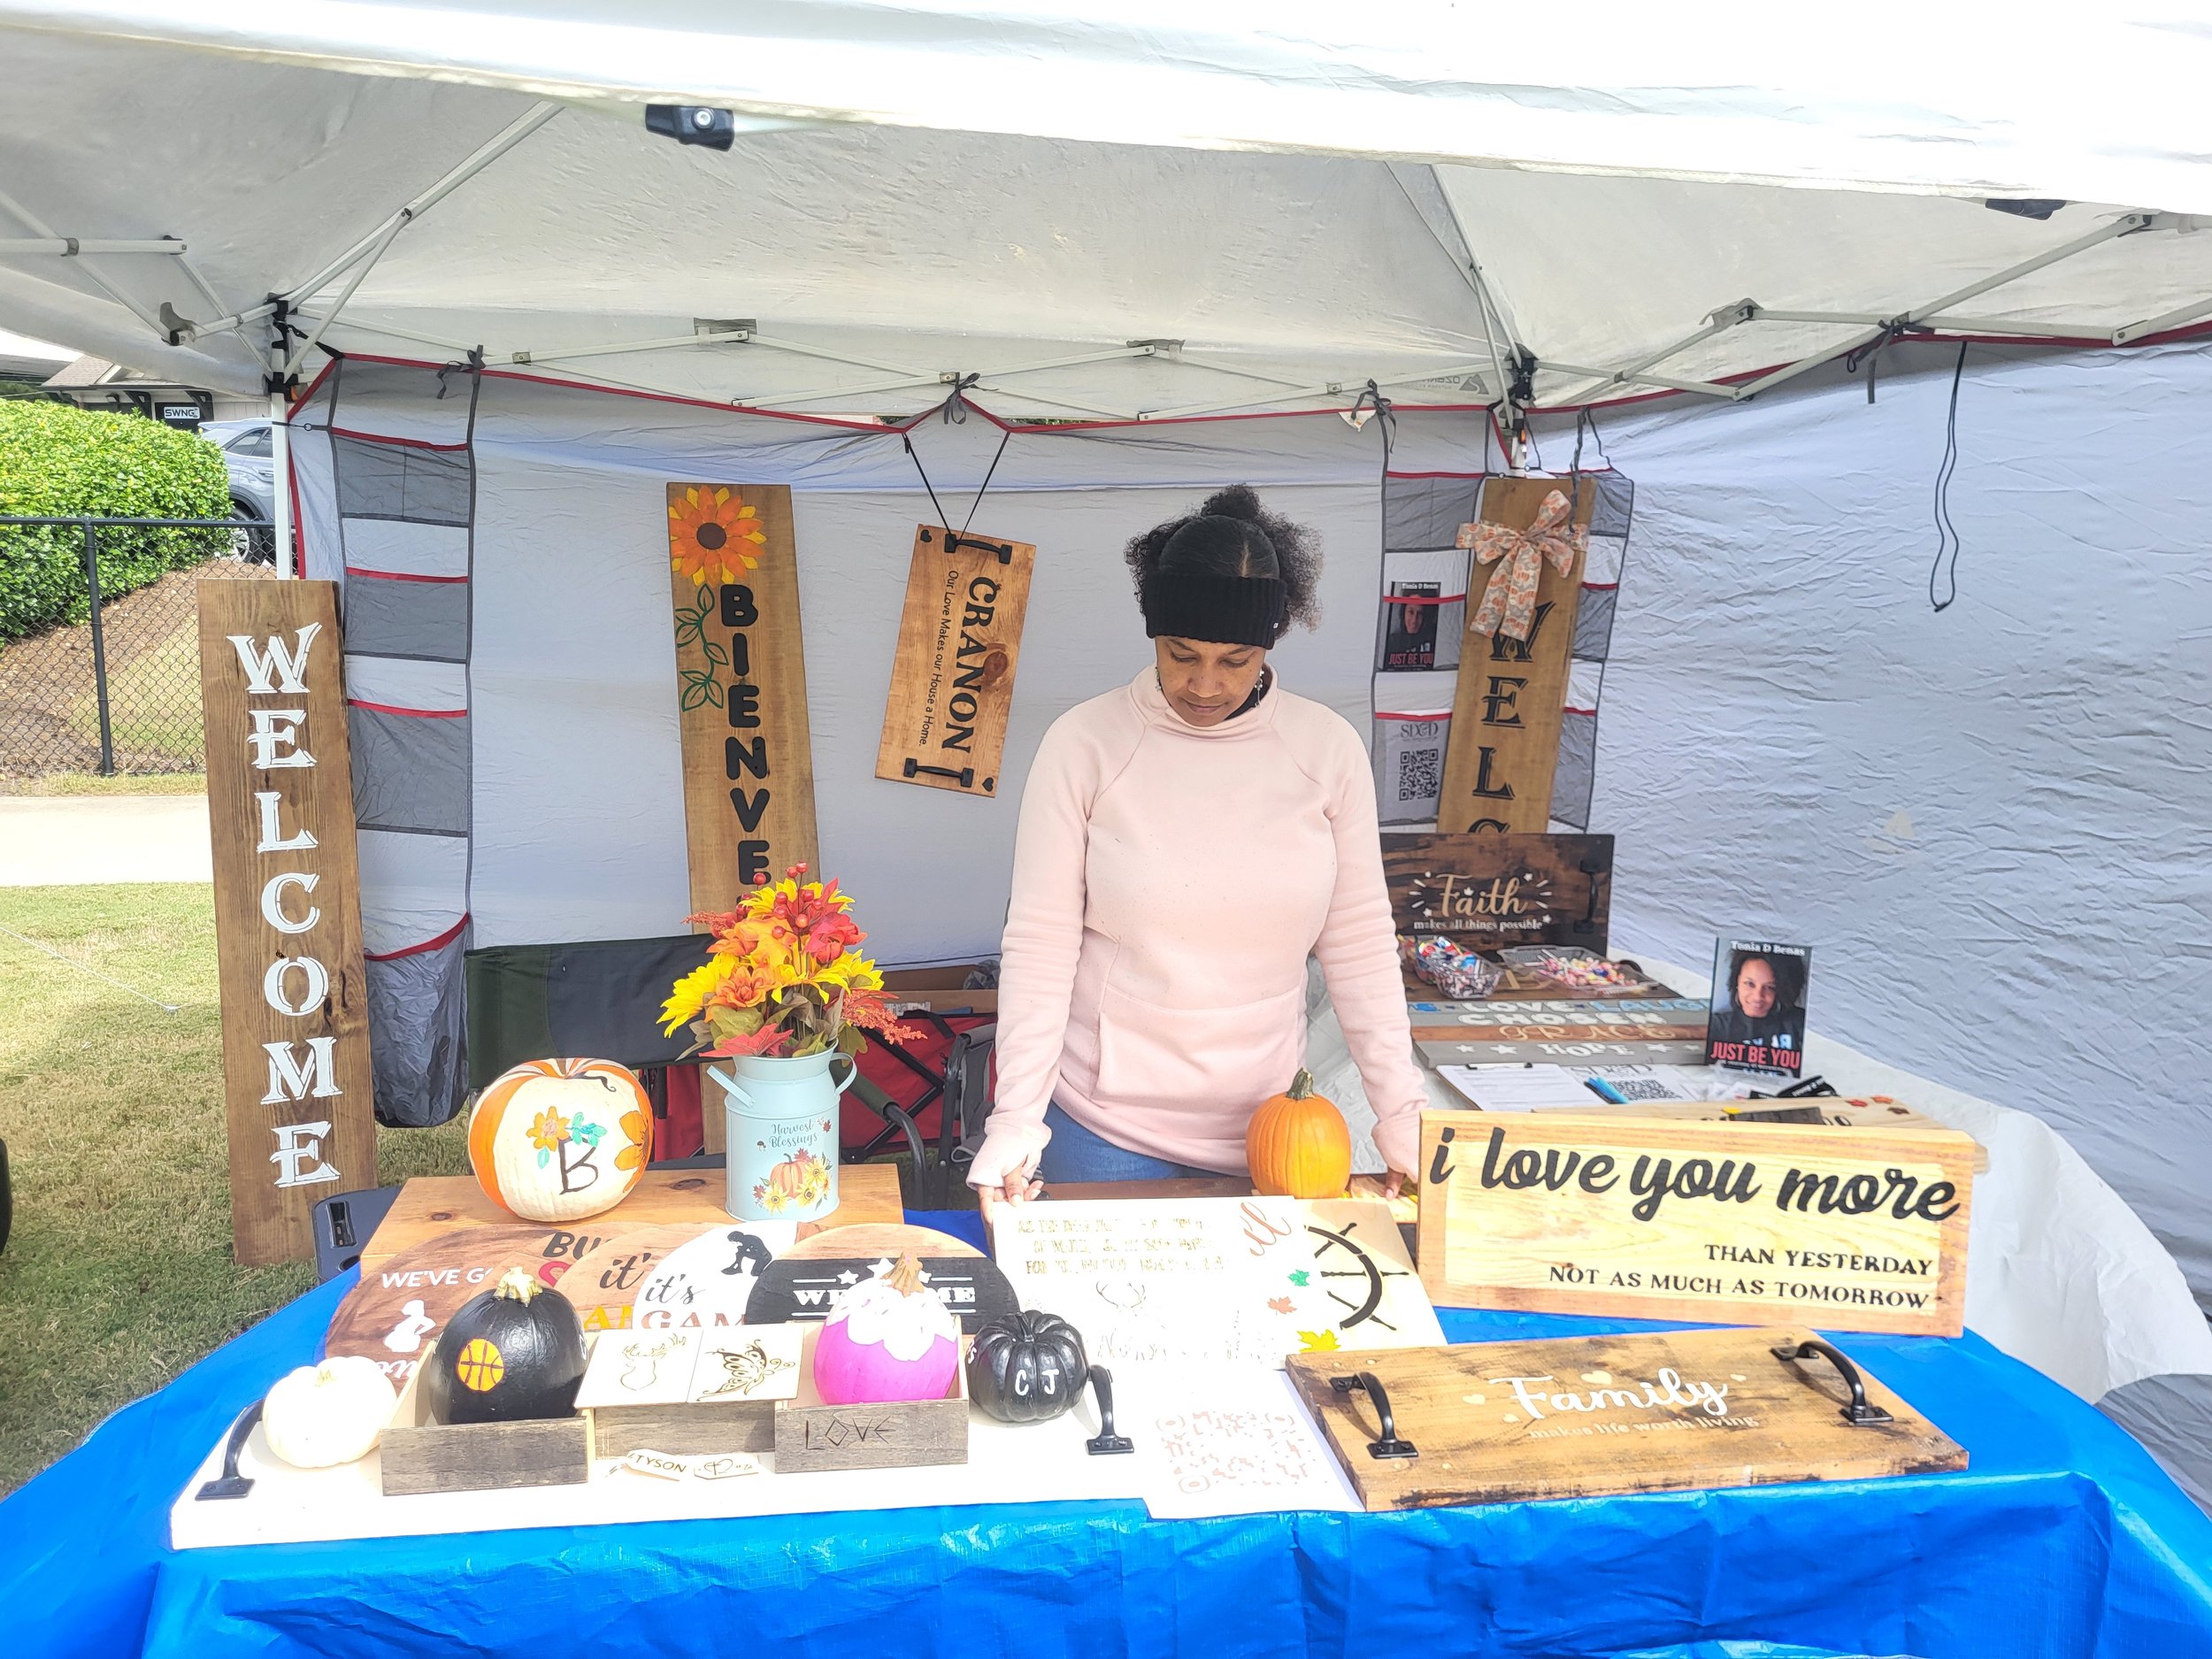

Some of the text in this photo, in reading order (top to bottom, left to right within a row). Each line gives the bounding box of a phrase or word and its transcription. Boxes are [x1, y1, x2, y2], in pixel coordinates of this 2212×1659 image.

[947, 570, 959, 589] Our
[941, 592, 956, 616] Love
[935, 618, 951, 651] Makes
[933, 654, 943, 672] our
[941, 576, 998, 754] CRANON
[1388, 653, 1433, 665] JUST BE YOU
[926, 672, 942, 704] House
[1467, 600, 1555, 833] WEL
[720, 584, 771, 904] BIENVE
[227, 623, 343, 1188] WELCOME
[1436, 873, 1528, 917] Faith
[1465, 919, 1497, 931] things
[1499, 918, 1543, 933] possible
[1458, 1012, 1667, 1025] CHOSEN
[1462, 1000, 1575, 1013] LOVE
[1537, 1042, 1635, 1056] HOPE
[1710, 1041, 1746, 1061] JUST
[1747, 1045, 1768, 1064] BE
[1770, 1048, 1801, 1069] YOU
[772, 1118, 814, 1134] Harvest
[769, 1133, 818, 1148] Blessings
[557, 1137, 600, 1195] B
[1430, 1126, 1961, 1222] i love you more
[542, 1232, 613, 1260] BU
[1704, 1244, 1932, 1276] THAN YESTERDAY
[381, 1269, 461, 1288] WE'VE
[645, 1274, 706, 1305] it's
[1550, 1266, 1929, 1309] NOT AS MUCH AS TOMORROW
[1488, 1367, 1728, 1420] Family
[805, 1415, 896, 1450] LOVE
[1596, 1422, 1630, 1435] life
[1633, 1417, 1695, 1432] worth
[1699, 1415, 1759, 1430] living
[634, 1454, 687, 1473] TYSON
